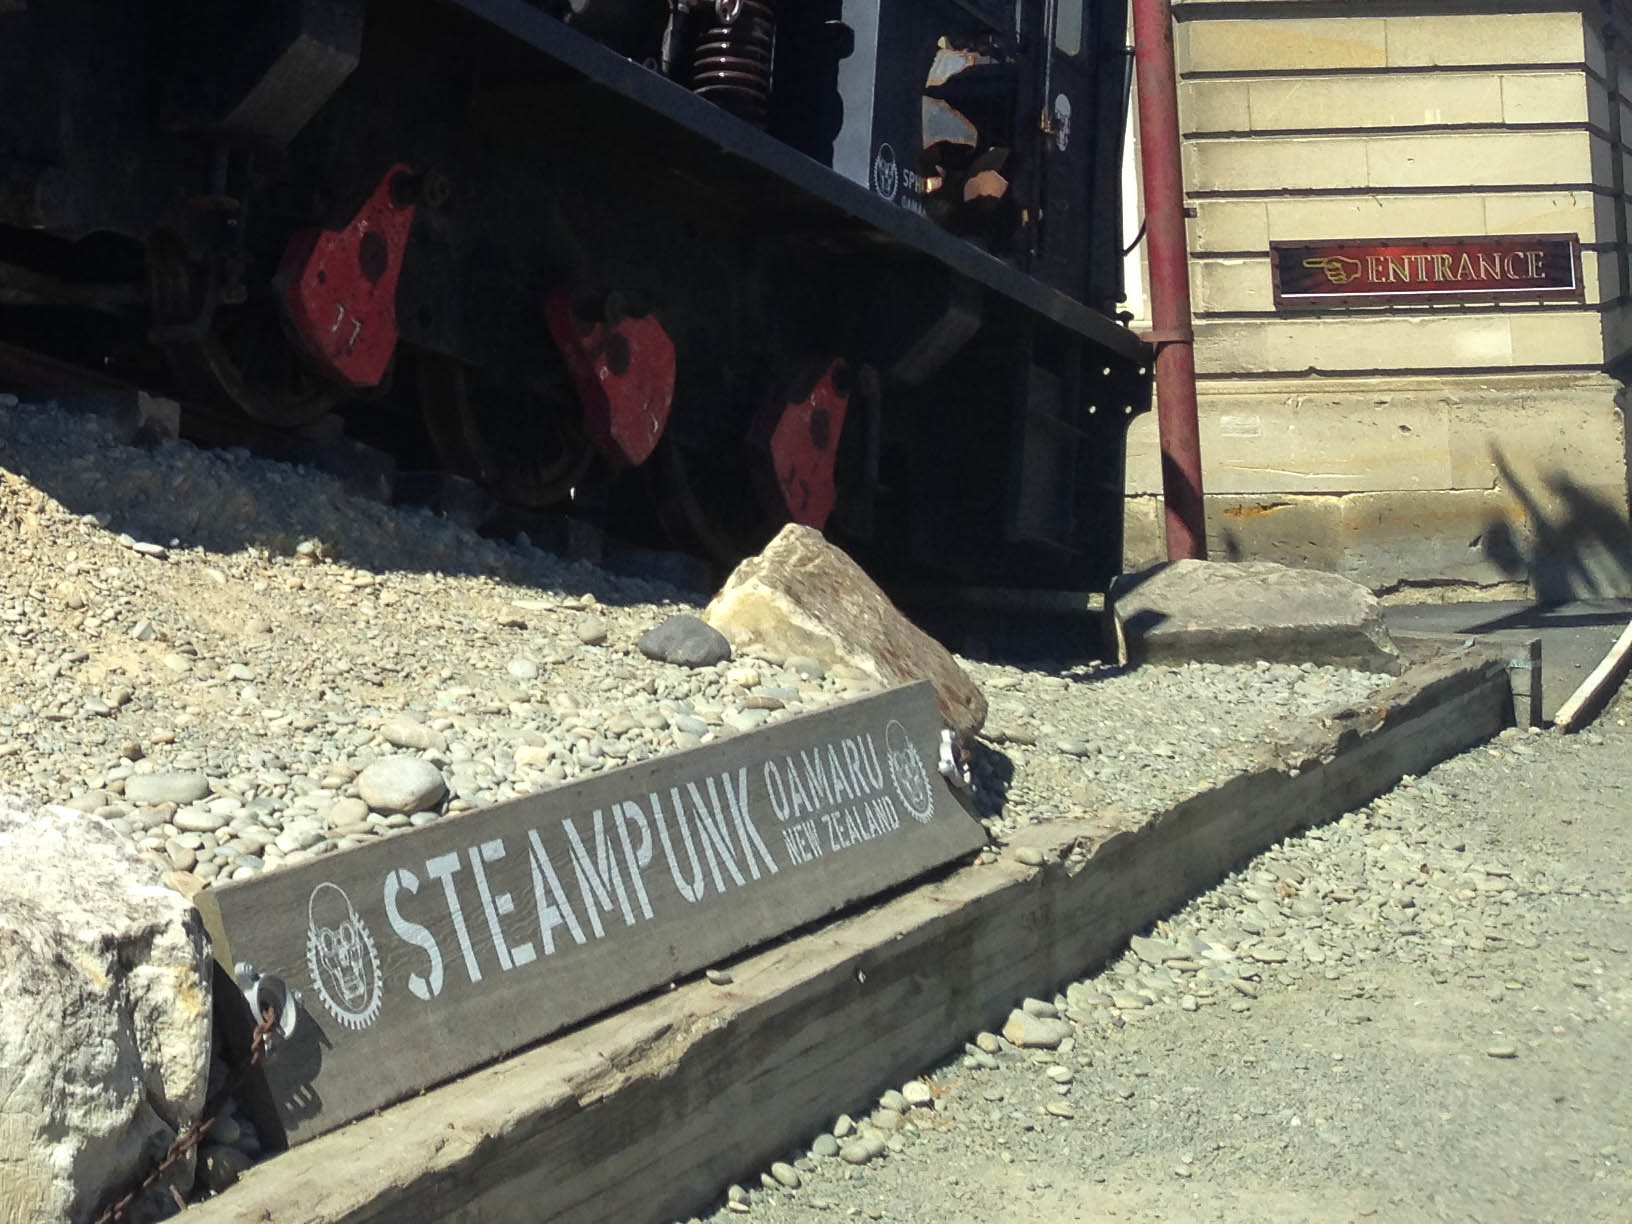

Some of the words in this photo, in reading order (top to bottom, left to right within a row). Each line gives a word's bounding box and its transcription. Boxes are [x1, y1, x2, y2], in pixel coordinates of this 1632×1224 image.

[1366, 251, 1546, 284] ENTRANCE
[781, 819, 823, 866] NEW
[820, 795, 901, 852] ZEALAND
[383, 766, 780, 1001] STEAMPUNK
[763, 733, 886, 823] OAMARU
